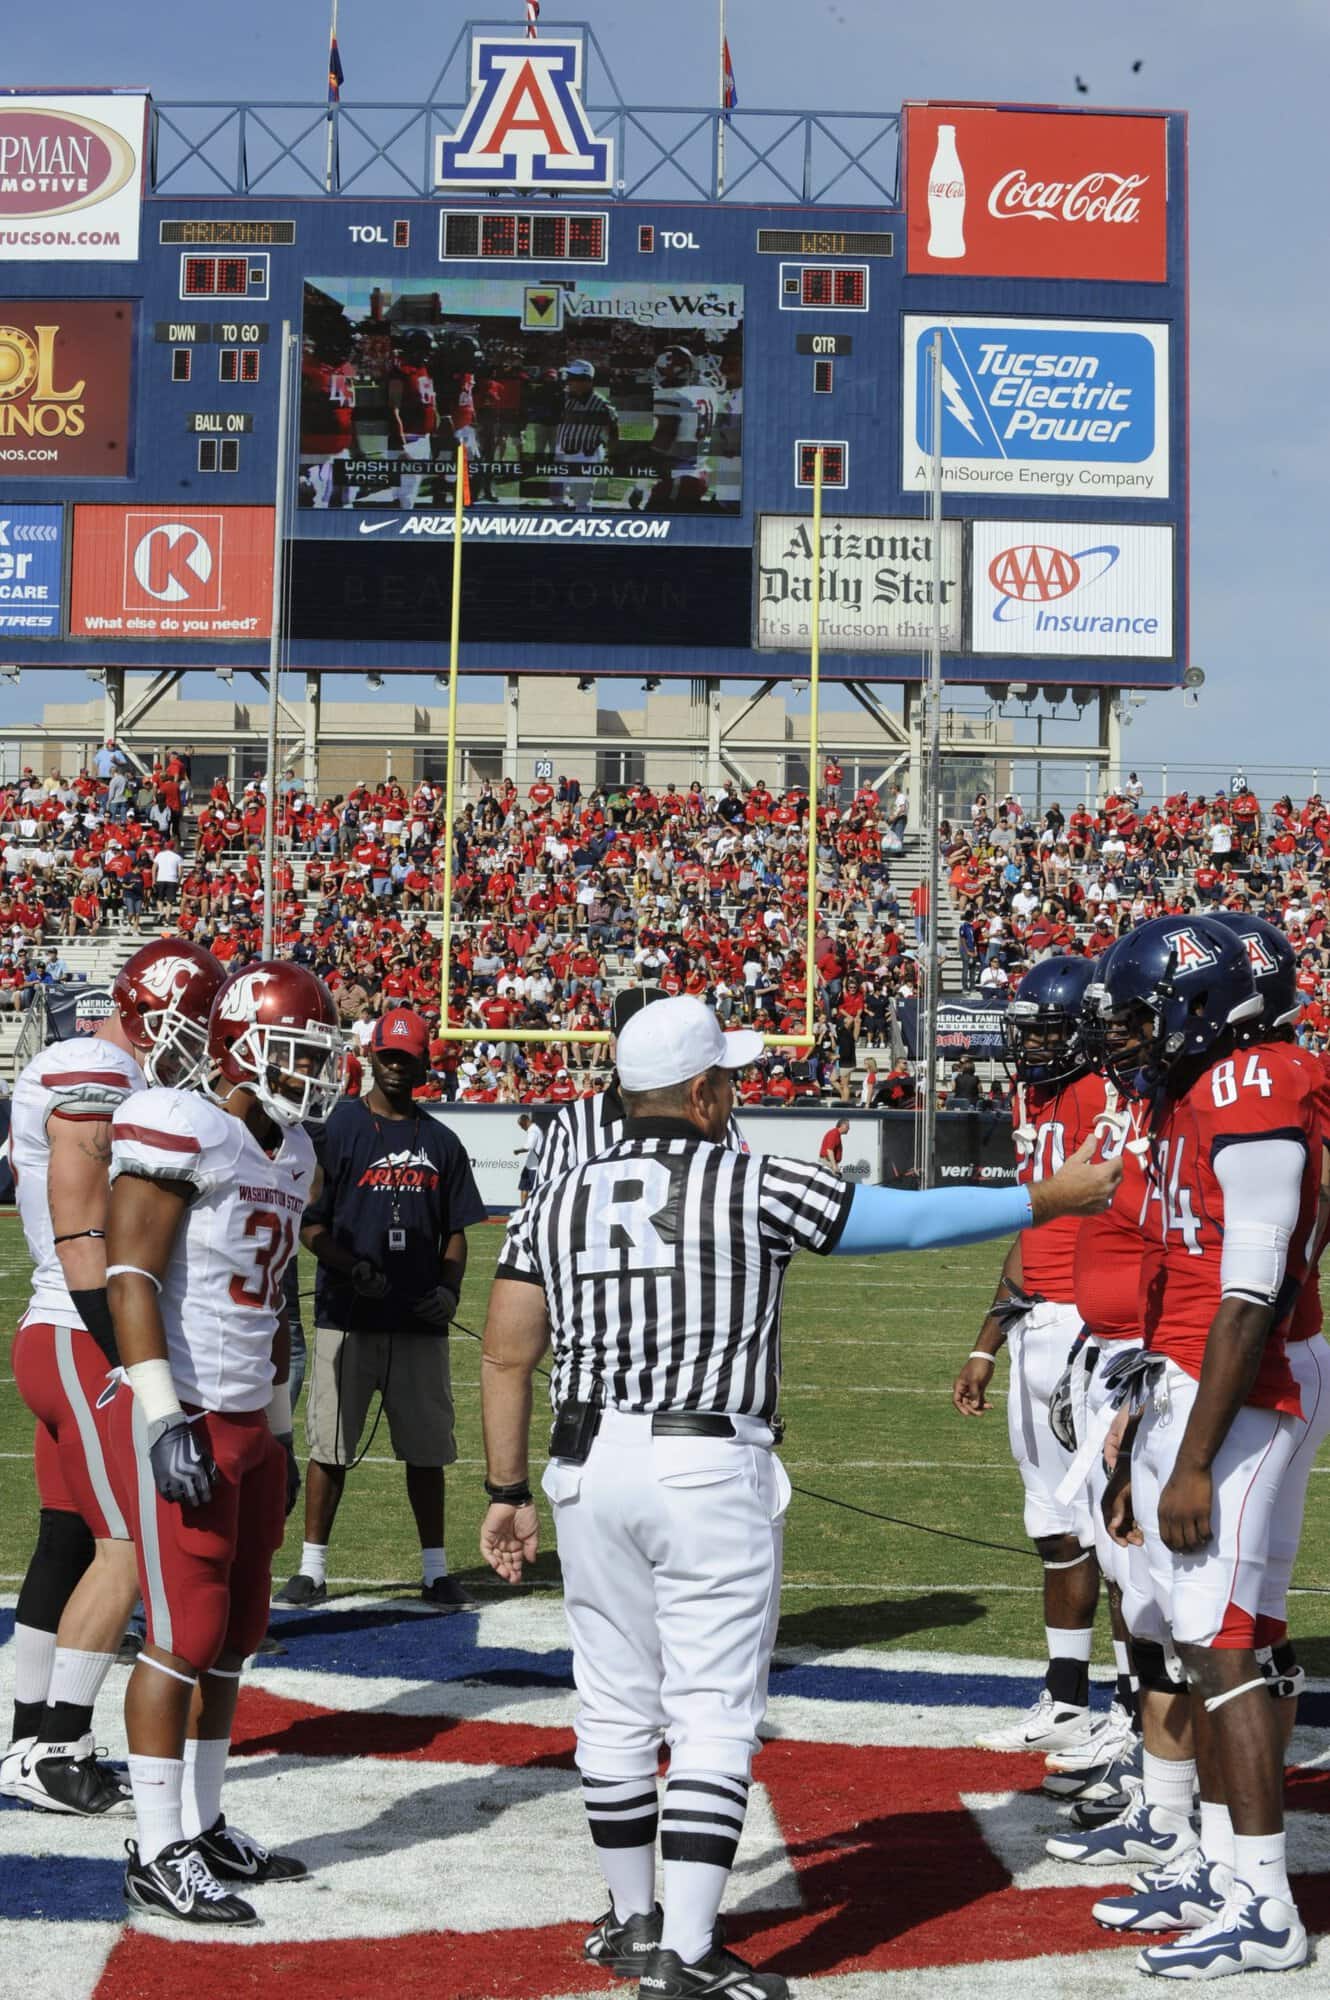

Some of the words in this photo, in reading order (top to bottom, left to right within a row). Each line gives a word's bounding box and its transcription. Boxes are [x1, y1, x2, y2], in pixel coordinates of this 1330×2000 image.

[0, 136, 93, 175] PMAN
[1, 178, 88, 192] MOTIVE
[988, 169, 1150, 223] Coca-Cola
[184, 223, 272, 243] ARIZONA
[348, 226, 388, 243] TOL
[660, 232, 700, 248] TOL
[802, 233, 845, 255] WSU
[169, 325, 196, 341] DWN
[222, 325, 238, 341] TO
[241, 325, 260, 341] GO
[812, 336, 836, 353] QTR
[977, 344, 1099, 378] Tucson
[989, 377, 1132, 411] Electric
[195, 414, 223, 431] BALL
[227, 414, 244, 431] ON
[1003, 410, 1131, 443] Power
[345, 461, 456, 473] WASHINGTON
[469, 463, 522, 474] STATE
[536, 464, 569, 475] HAS
[581, 464, 614, 476] WON
[915, 466, 927, 479] A
[1019, 468, 1074, 487] Energy
[1079, 470, 1154, 488] Company
[400, 516, 671, 539] ARIZONAWILDCATS.COM
[782, 523, 932, 561] Arizona
[999, 546, 1072, 600] AAA
[0, 585, 48, 599] CARE
[760, 565, 863, 612] Daily
[873, 568, 957, 605] Star
[85, 617, 123, 629] What
[127, 617, 156, 629] else
[160, 617, 178, 630] do
[183, 620, 209, 632] you
[212, 618, 258, 630] need?
[761, 618, 791, 635] It's
[798, 622, 809, 635] a
[818, 618, 889, 637] Tucson
[1035, 611, 1159, 634] Insurance
[537, 762, 551, 777] 28
[77, 1000, 116, 1008] AMERICA
[937, 1014, 973, 1023] ERICAN
[1211, 1055, 1273, 1108] 84
[240, 1185, 286, 1207] WASHINGTON
[577, 1158, 676, 1275] R
[46, 1745, 68, 1754] NIKE
